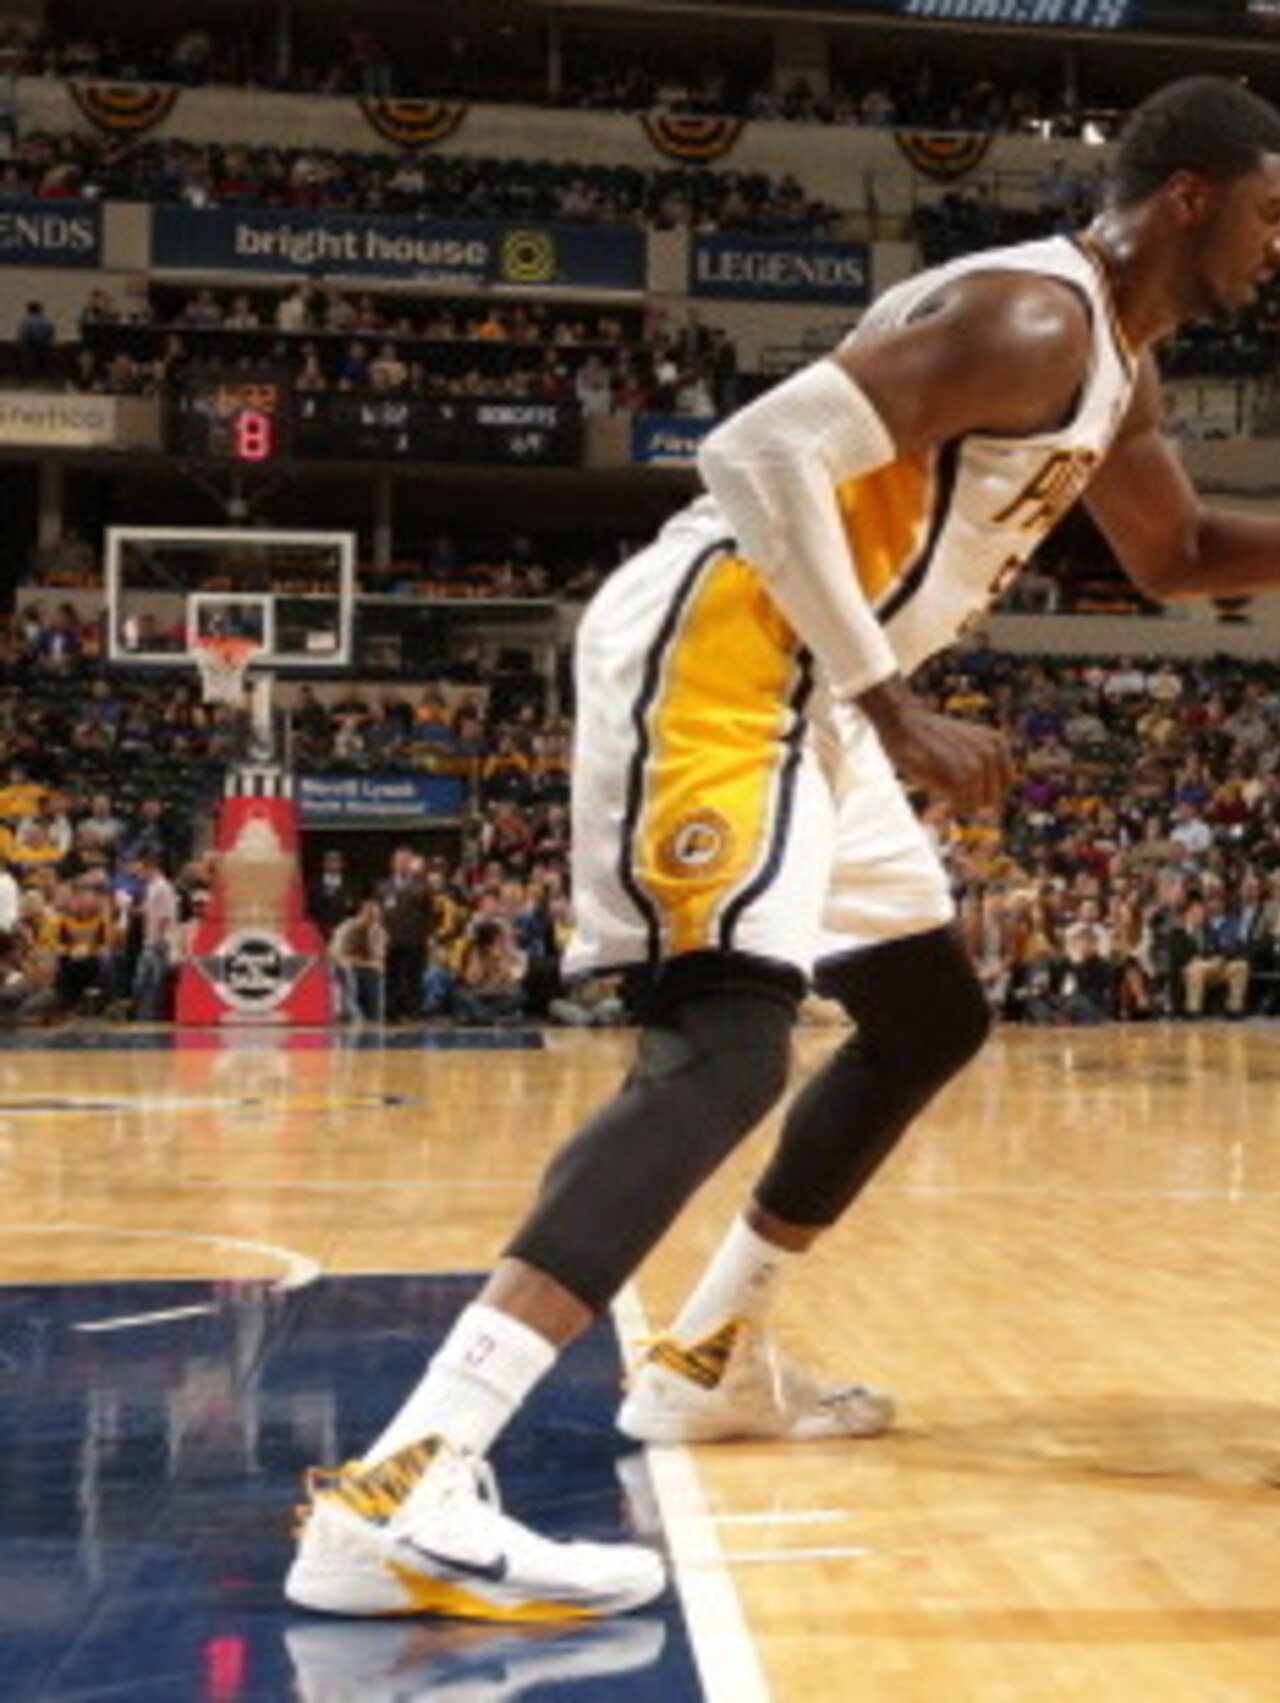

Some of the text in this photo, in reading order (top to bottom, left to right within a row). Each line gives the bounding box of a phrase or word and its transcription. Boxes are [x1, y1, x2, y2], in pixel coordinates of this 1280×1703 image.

[235, 224, 488, 265] bright house
[697, 249, 864, 288] LEGENDS
[238, 409, 272, 460] 8
